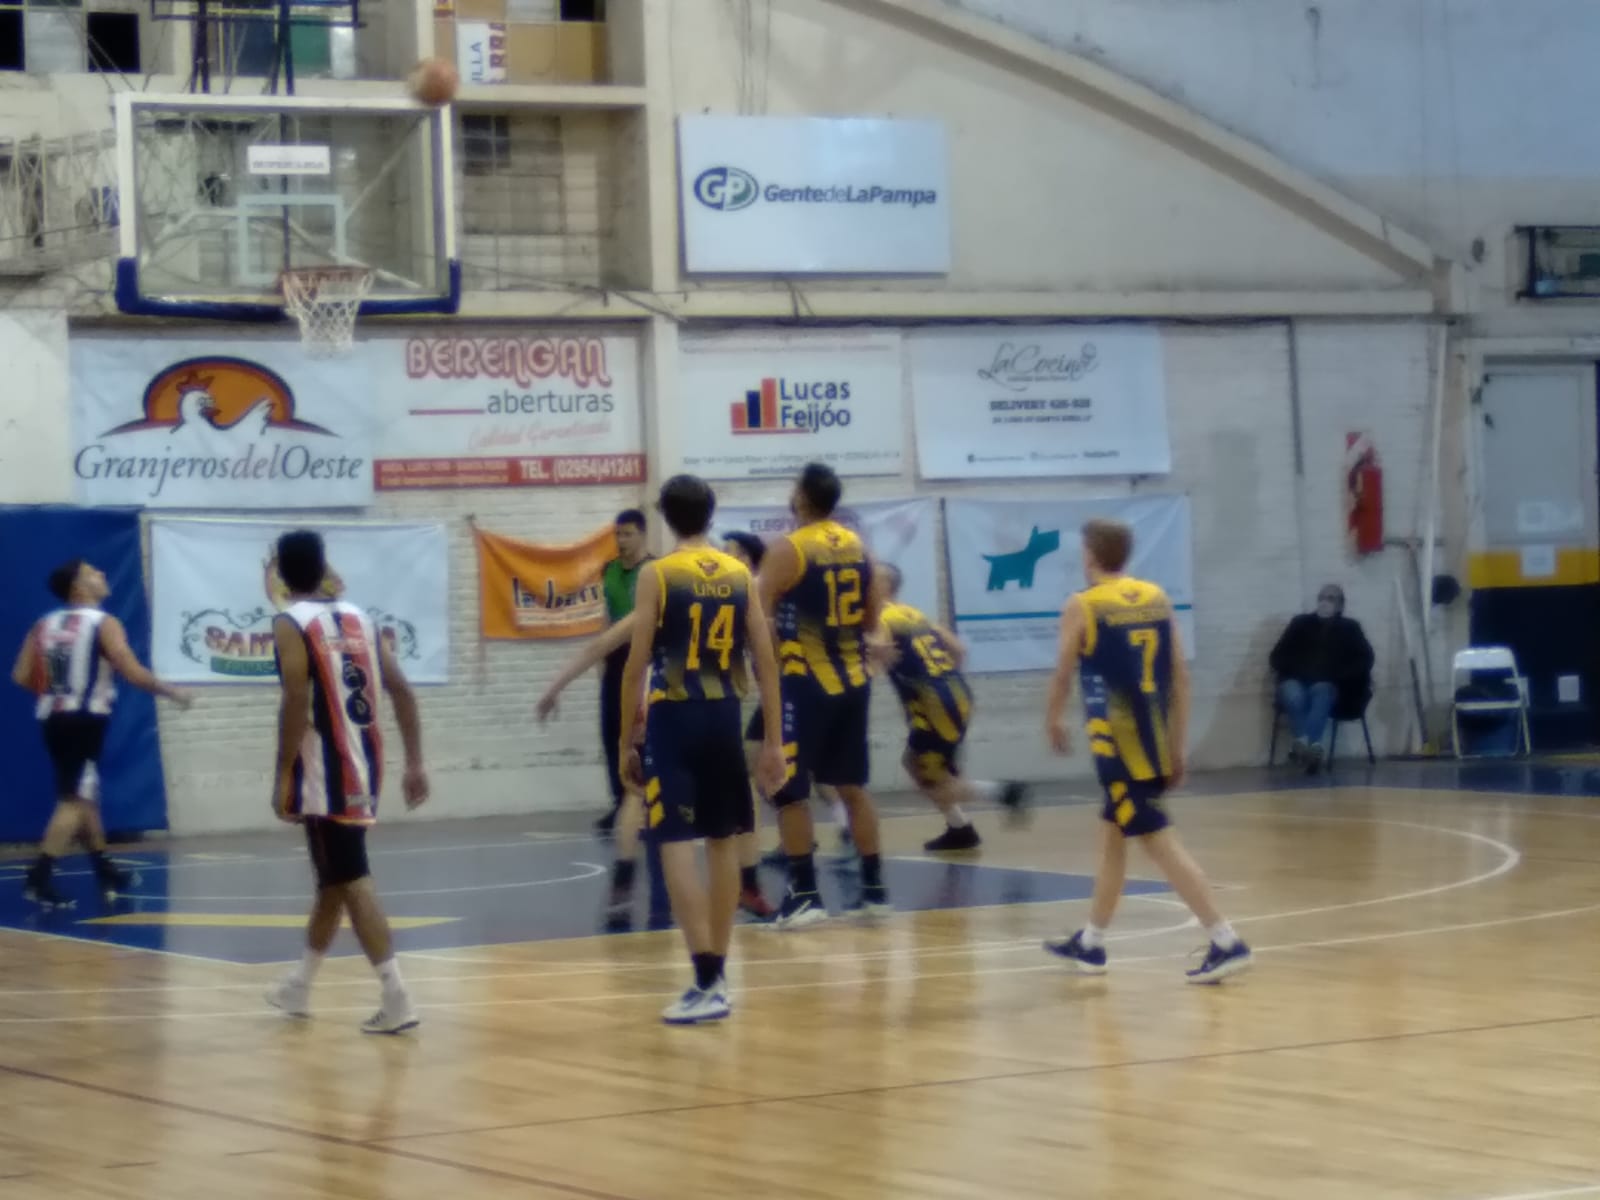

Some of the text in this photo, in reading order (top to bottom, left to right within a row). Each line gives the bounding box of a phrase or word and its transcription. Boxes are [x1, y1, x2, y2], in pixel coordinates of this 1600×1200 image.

[698, 170, 752, 209] GP
[763, 184, 937, 207] GentedeLaPampa
[405, 337, 614, 388] BERENGAN
[487, 390, 615, 415] aberturas
[778, 377, 851, 401] Lucas
[780, 402, 852, 433] Feijóo
[73, 443, 364, 497] GranjerosdelOeste
[823, 567, 864, 626] 12
[686, 602, 735, 670] 14
[911, 633, 954, 677] 15
[1128, 628, 1159, 693] 7
